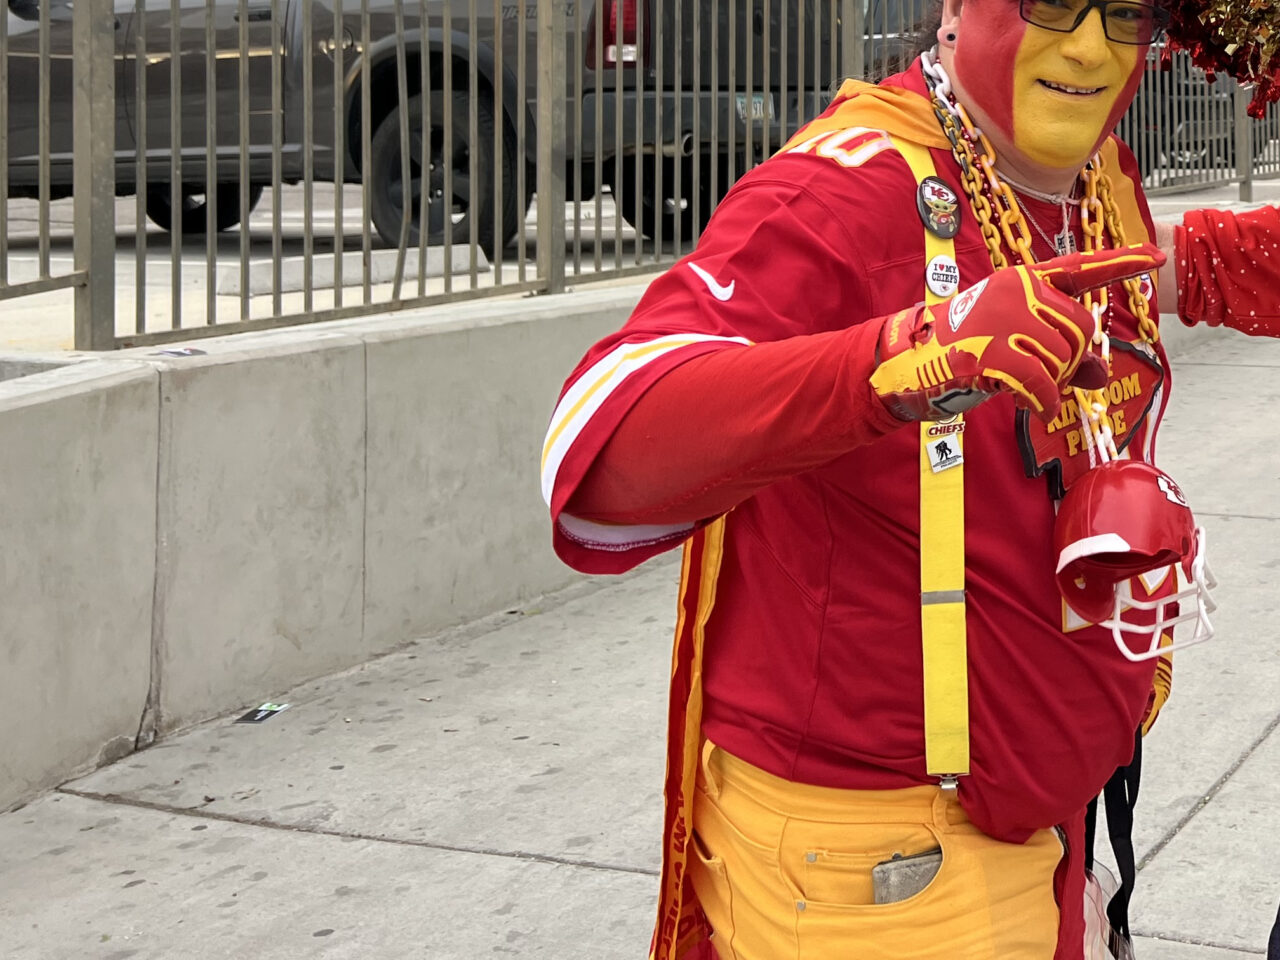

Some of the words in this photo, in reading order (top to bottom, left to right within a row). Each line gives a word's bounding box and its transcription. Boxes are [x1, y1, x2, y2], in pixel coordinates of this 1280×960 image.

[930, 186, 950, 201] KC
[933, 263, 938, 271] I
[945, 265, 957, 274] MY
[931, 272, 958, 284] CHIEFS
[928, 422, 965, 436] CHIEFS
